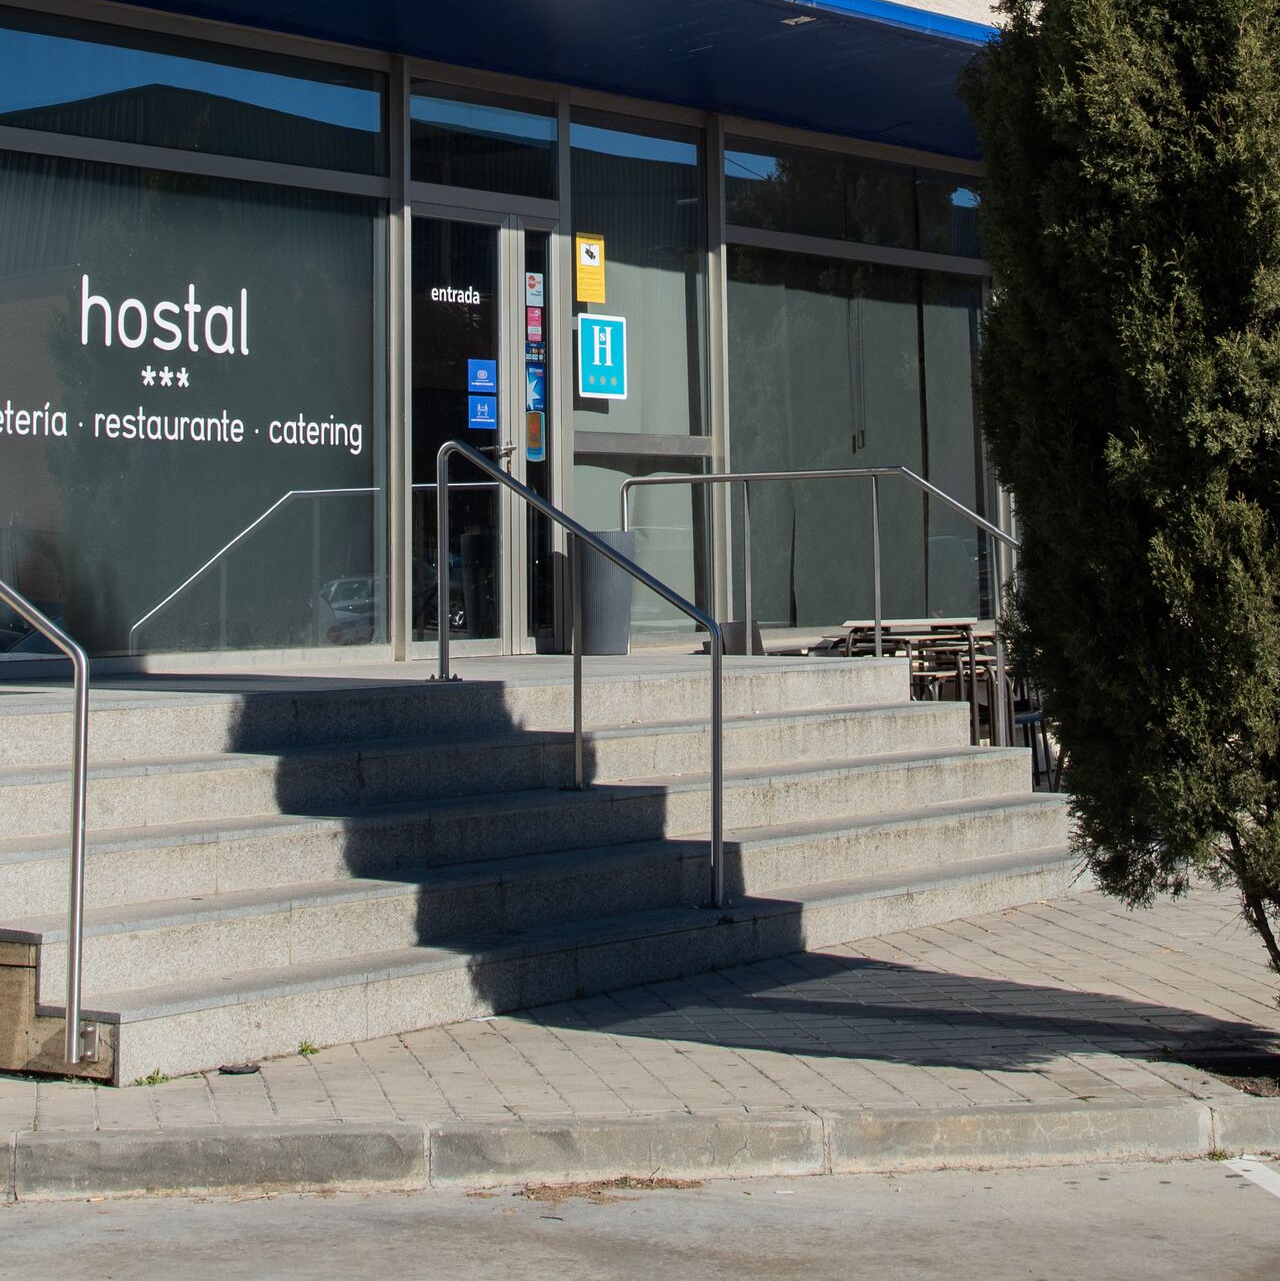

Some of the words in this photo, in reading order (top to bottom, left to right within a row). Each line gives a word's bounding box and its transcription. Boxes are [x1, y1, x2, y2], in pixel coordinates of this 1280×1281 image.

[80, 272, 251, 357] hostal
[430, 285, 481, 305] entrada
[93, 405, 246, 444] restaurante
[268, 412, 363, 456] catering
